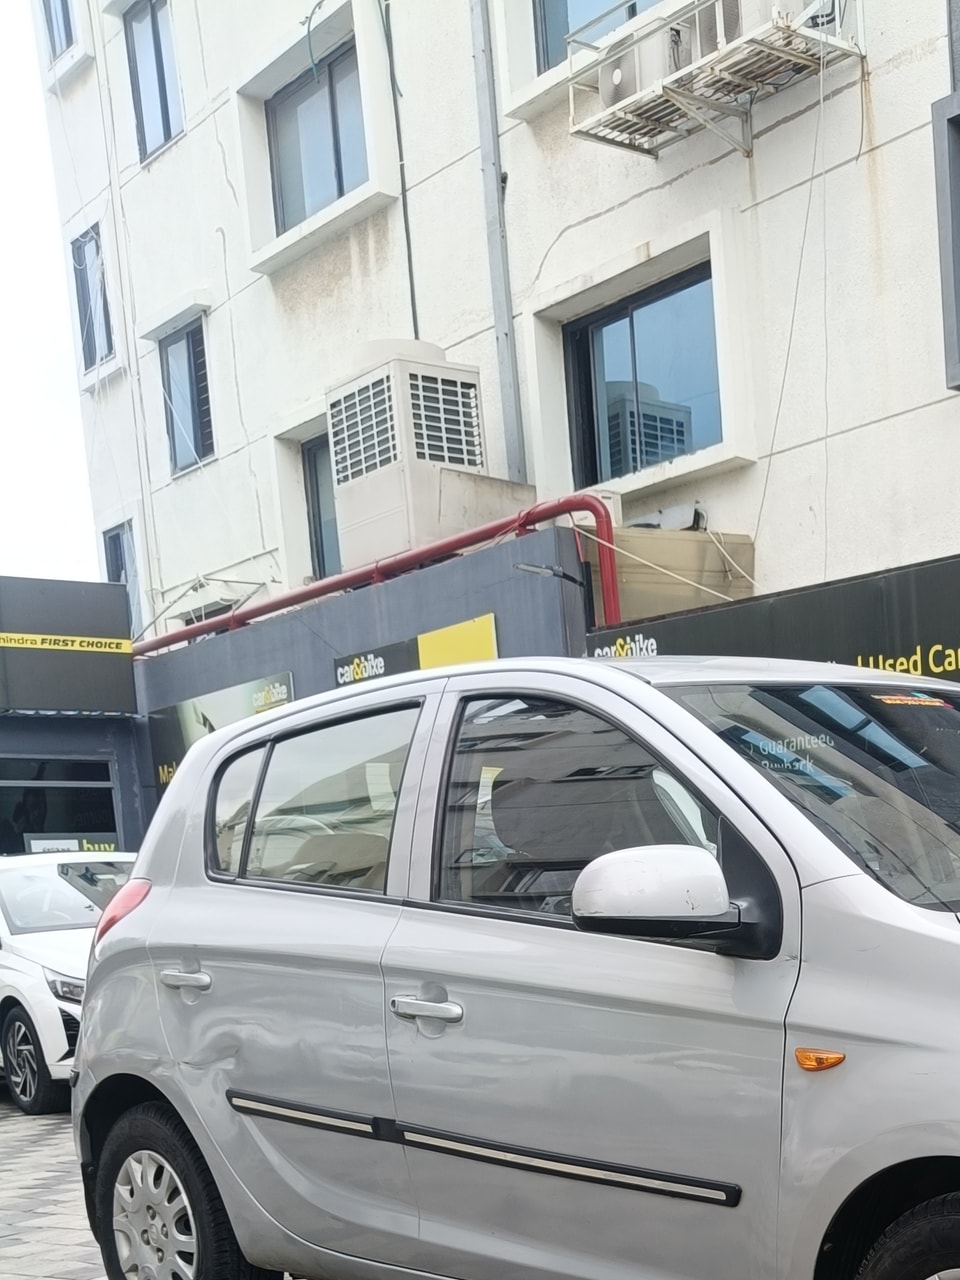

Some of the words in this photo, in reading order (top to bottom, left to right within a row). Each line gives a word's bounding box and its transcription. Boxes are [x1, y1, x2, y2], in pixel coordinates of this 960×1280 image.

[41, 638, 77, 647] FIRST
[79, 640, 123, 650] CHOICE
[337, 653, 385, 684] car&bike
